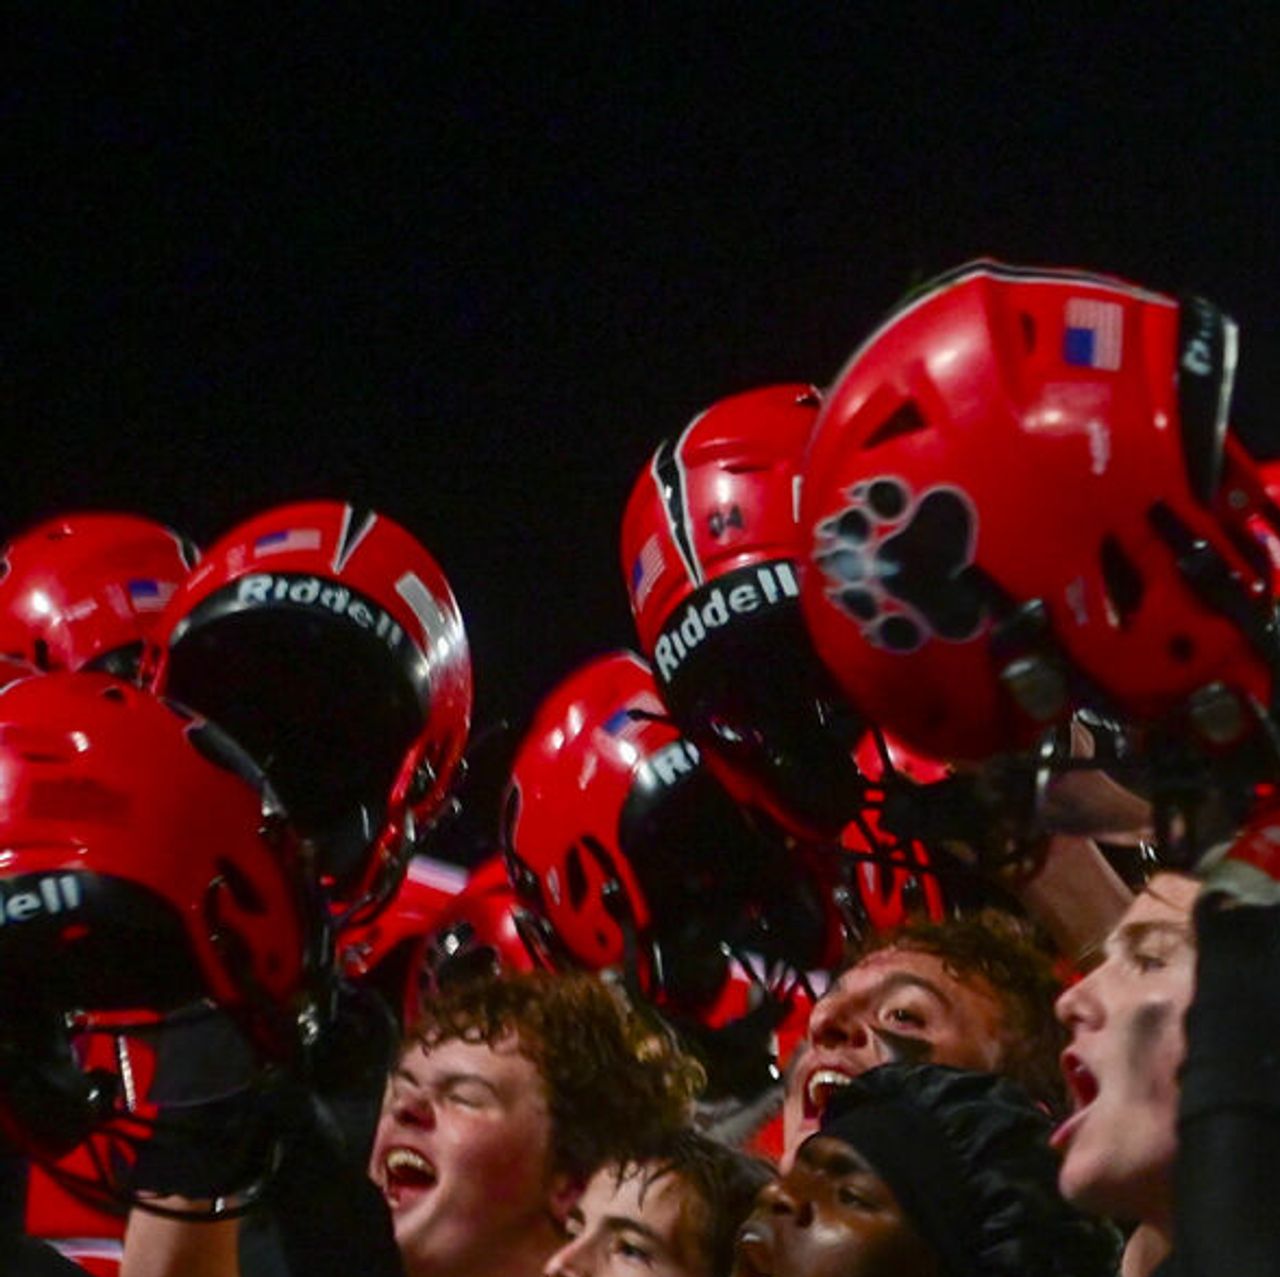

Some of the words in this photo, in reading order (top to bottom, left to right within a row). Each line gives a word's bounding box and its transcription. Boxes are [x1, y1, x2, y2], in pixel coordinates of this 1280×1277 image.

[236, 573, 402, 648] Riddell
[654, 562, 800, 684] Riddell
[0, 875, 79, 925] ell
